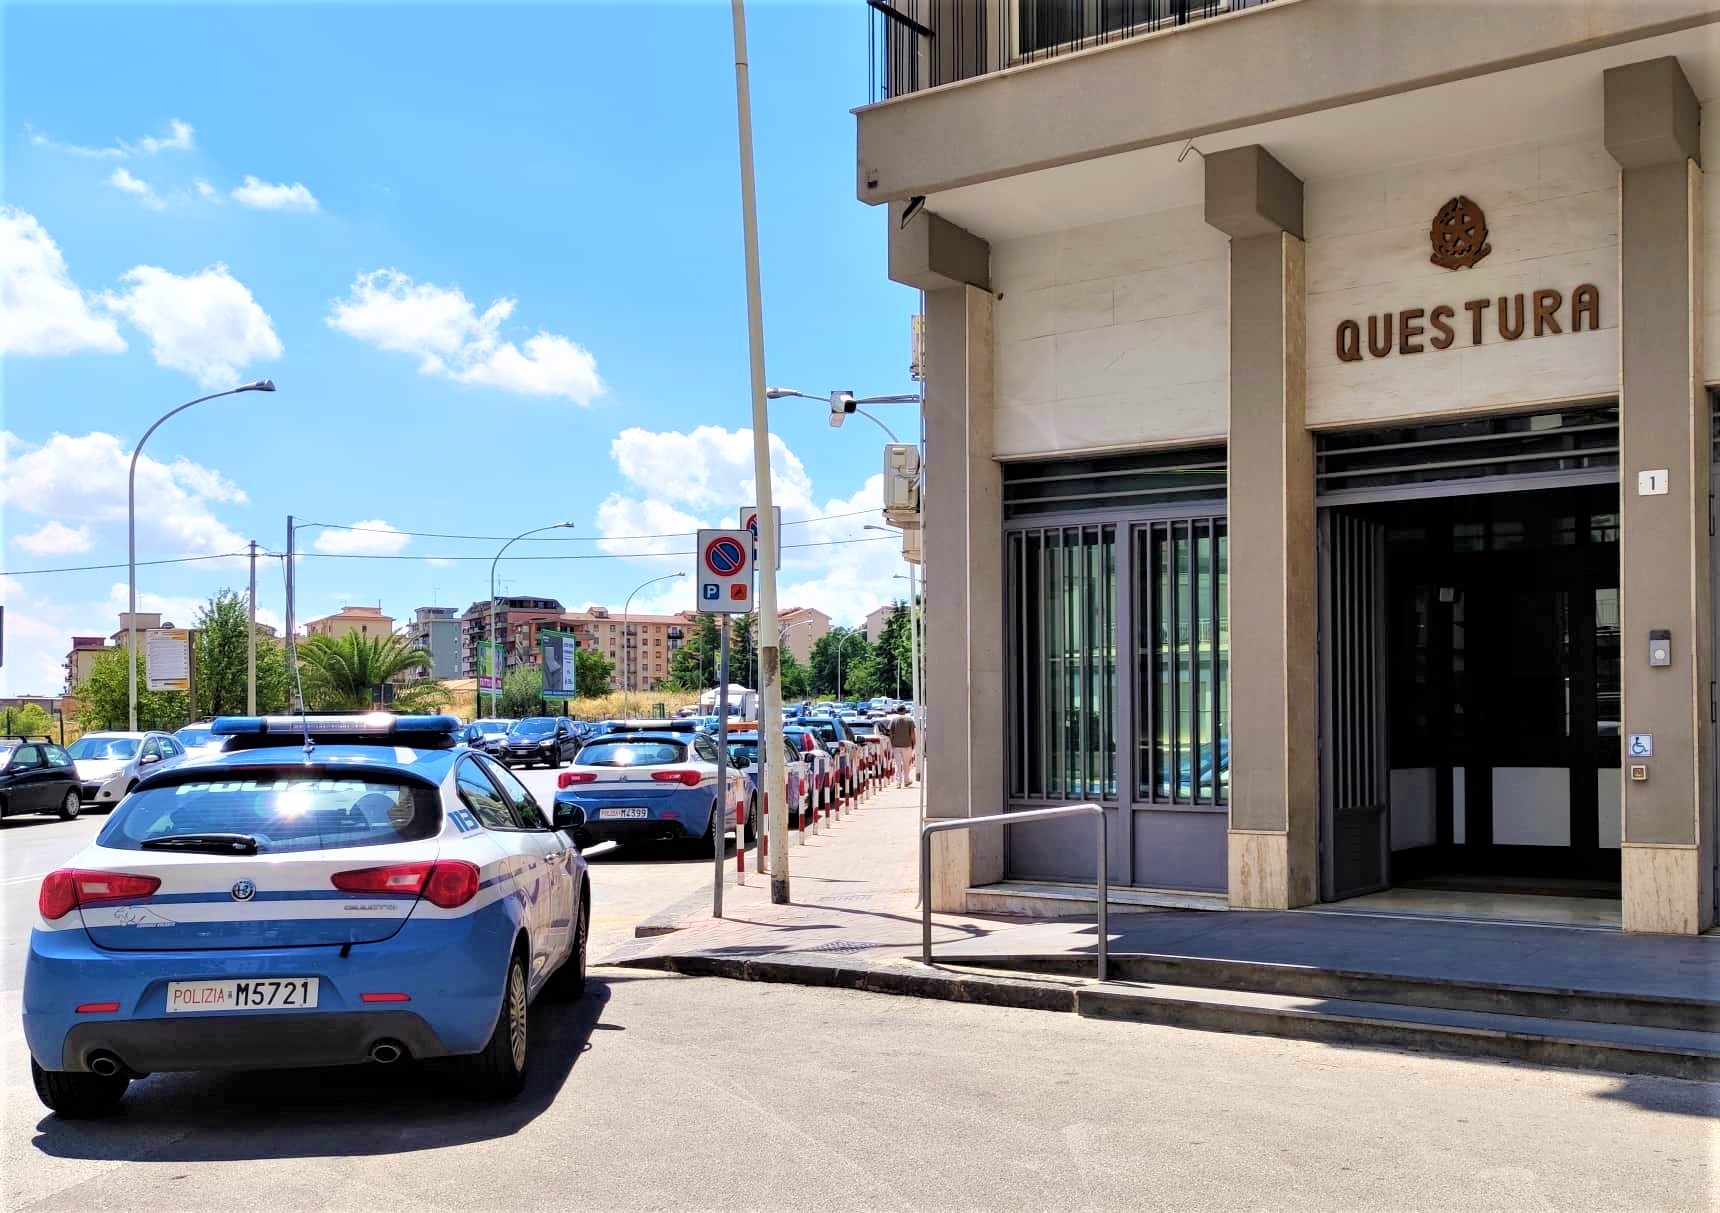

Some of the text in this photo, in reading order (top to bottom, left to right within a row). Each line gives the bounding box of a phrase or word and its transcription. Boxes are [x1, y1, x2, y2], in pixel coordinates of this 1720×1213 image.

[1336, 283, 1599, 362] QUESTURA
[1650, 476, 1655, 490] 1
[706, 585, 718, 598] P
[173, 981, 309, 1006] POLIZIA M5721
